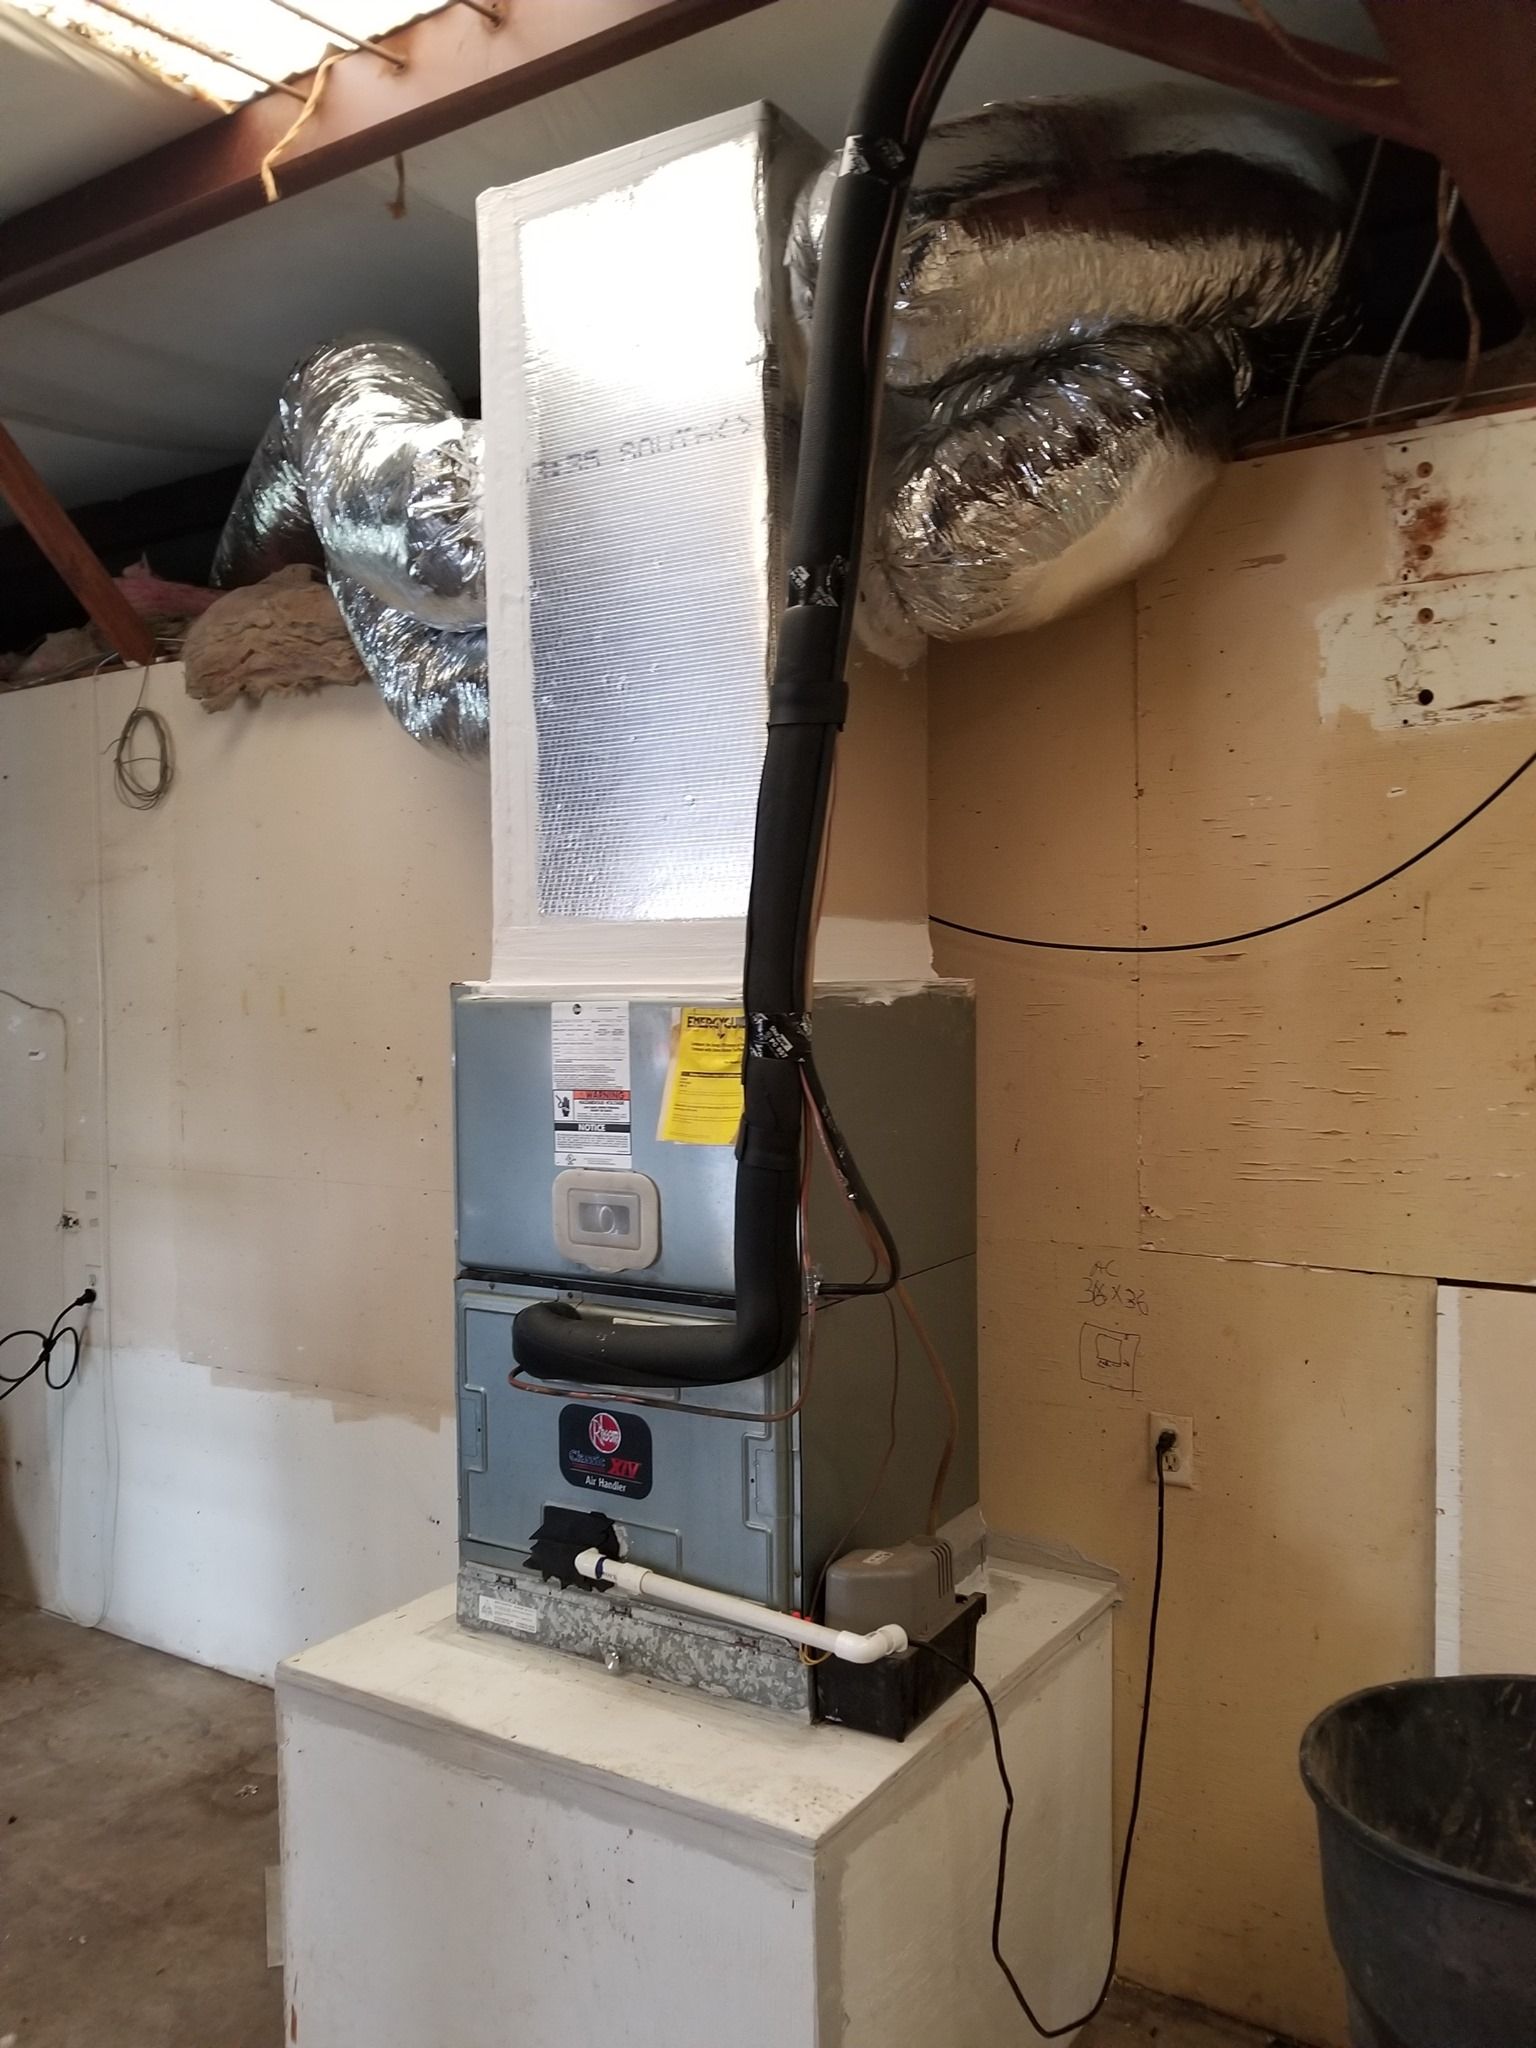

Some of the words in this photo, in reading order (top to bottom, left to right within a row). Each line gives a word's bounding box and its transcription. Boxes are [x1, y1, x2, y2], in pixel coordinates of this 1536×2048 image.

[585, 1090, 625, 1100] WARNING
[578, 1124, 606, 1132] NOTICE
[607, 1457, 642, 1479] XIV
[585, 1474, 597, 1486] Air
[598, 1477, 627, 1492] Handler
